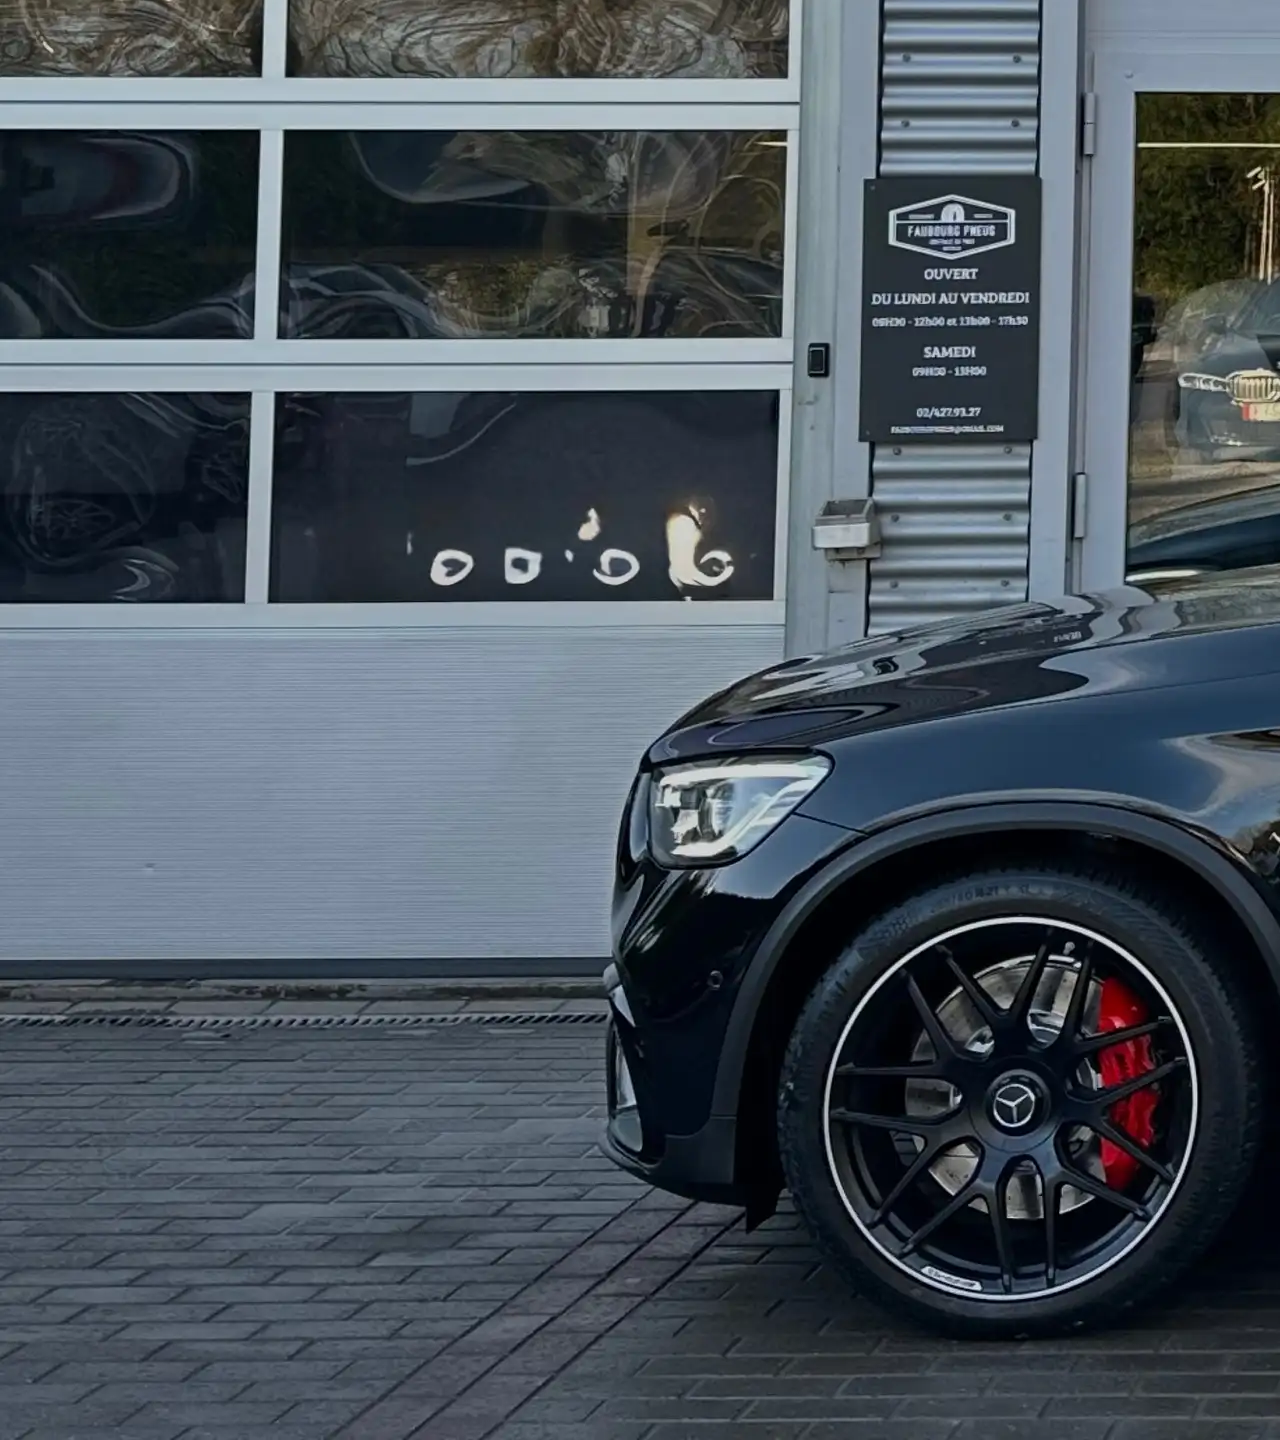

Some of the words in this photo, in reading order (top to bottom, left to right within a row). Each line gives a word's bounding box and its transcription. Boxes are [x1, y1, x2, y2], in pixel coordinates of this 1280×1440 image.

[907, 224, 961, 238] FAUBOURG
[963, 224, 996, 237] PNEUS
[923, 268, 979, 281] OUVERT
[871, 293, 891, 305] DU
[893, 293, 936, 305] LUNDI
[938, 292, 958, 305] AU
[960, 291, 1030, 304] VENDREDI
[923, 346, 976, 358] SAMEDI
